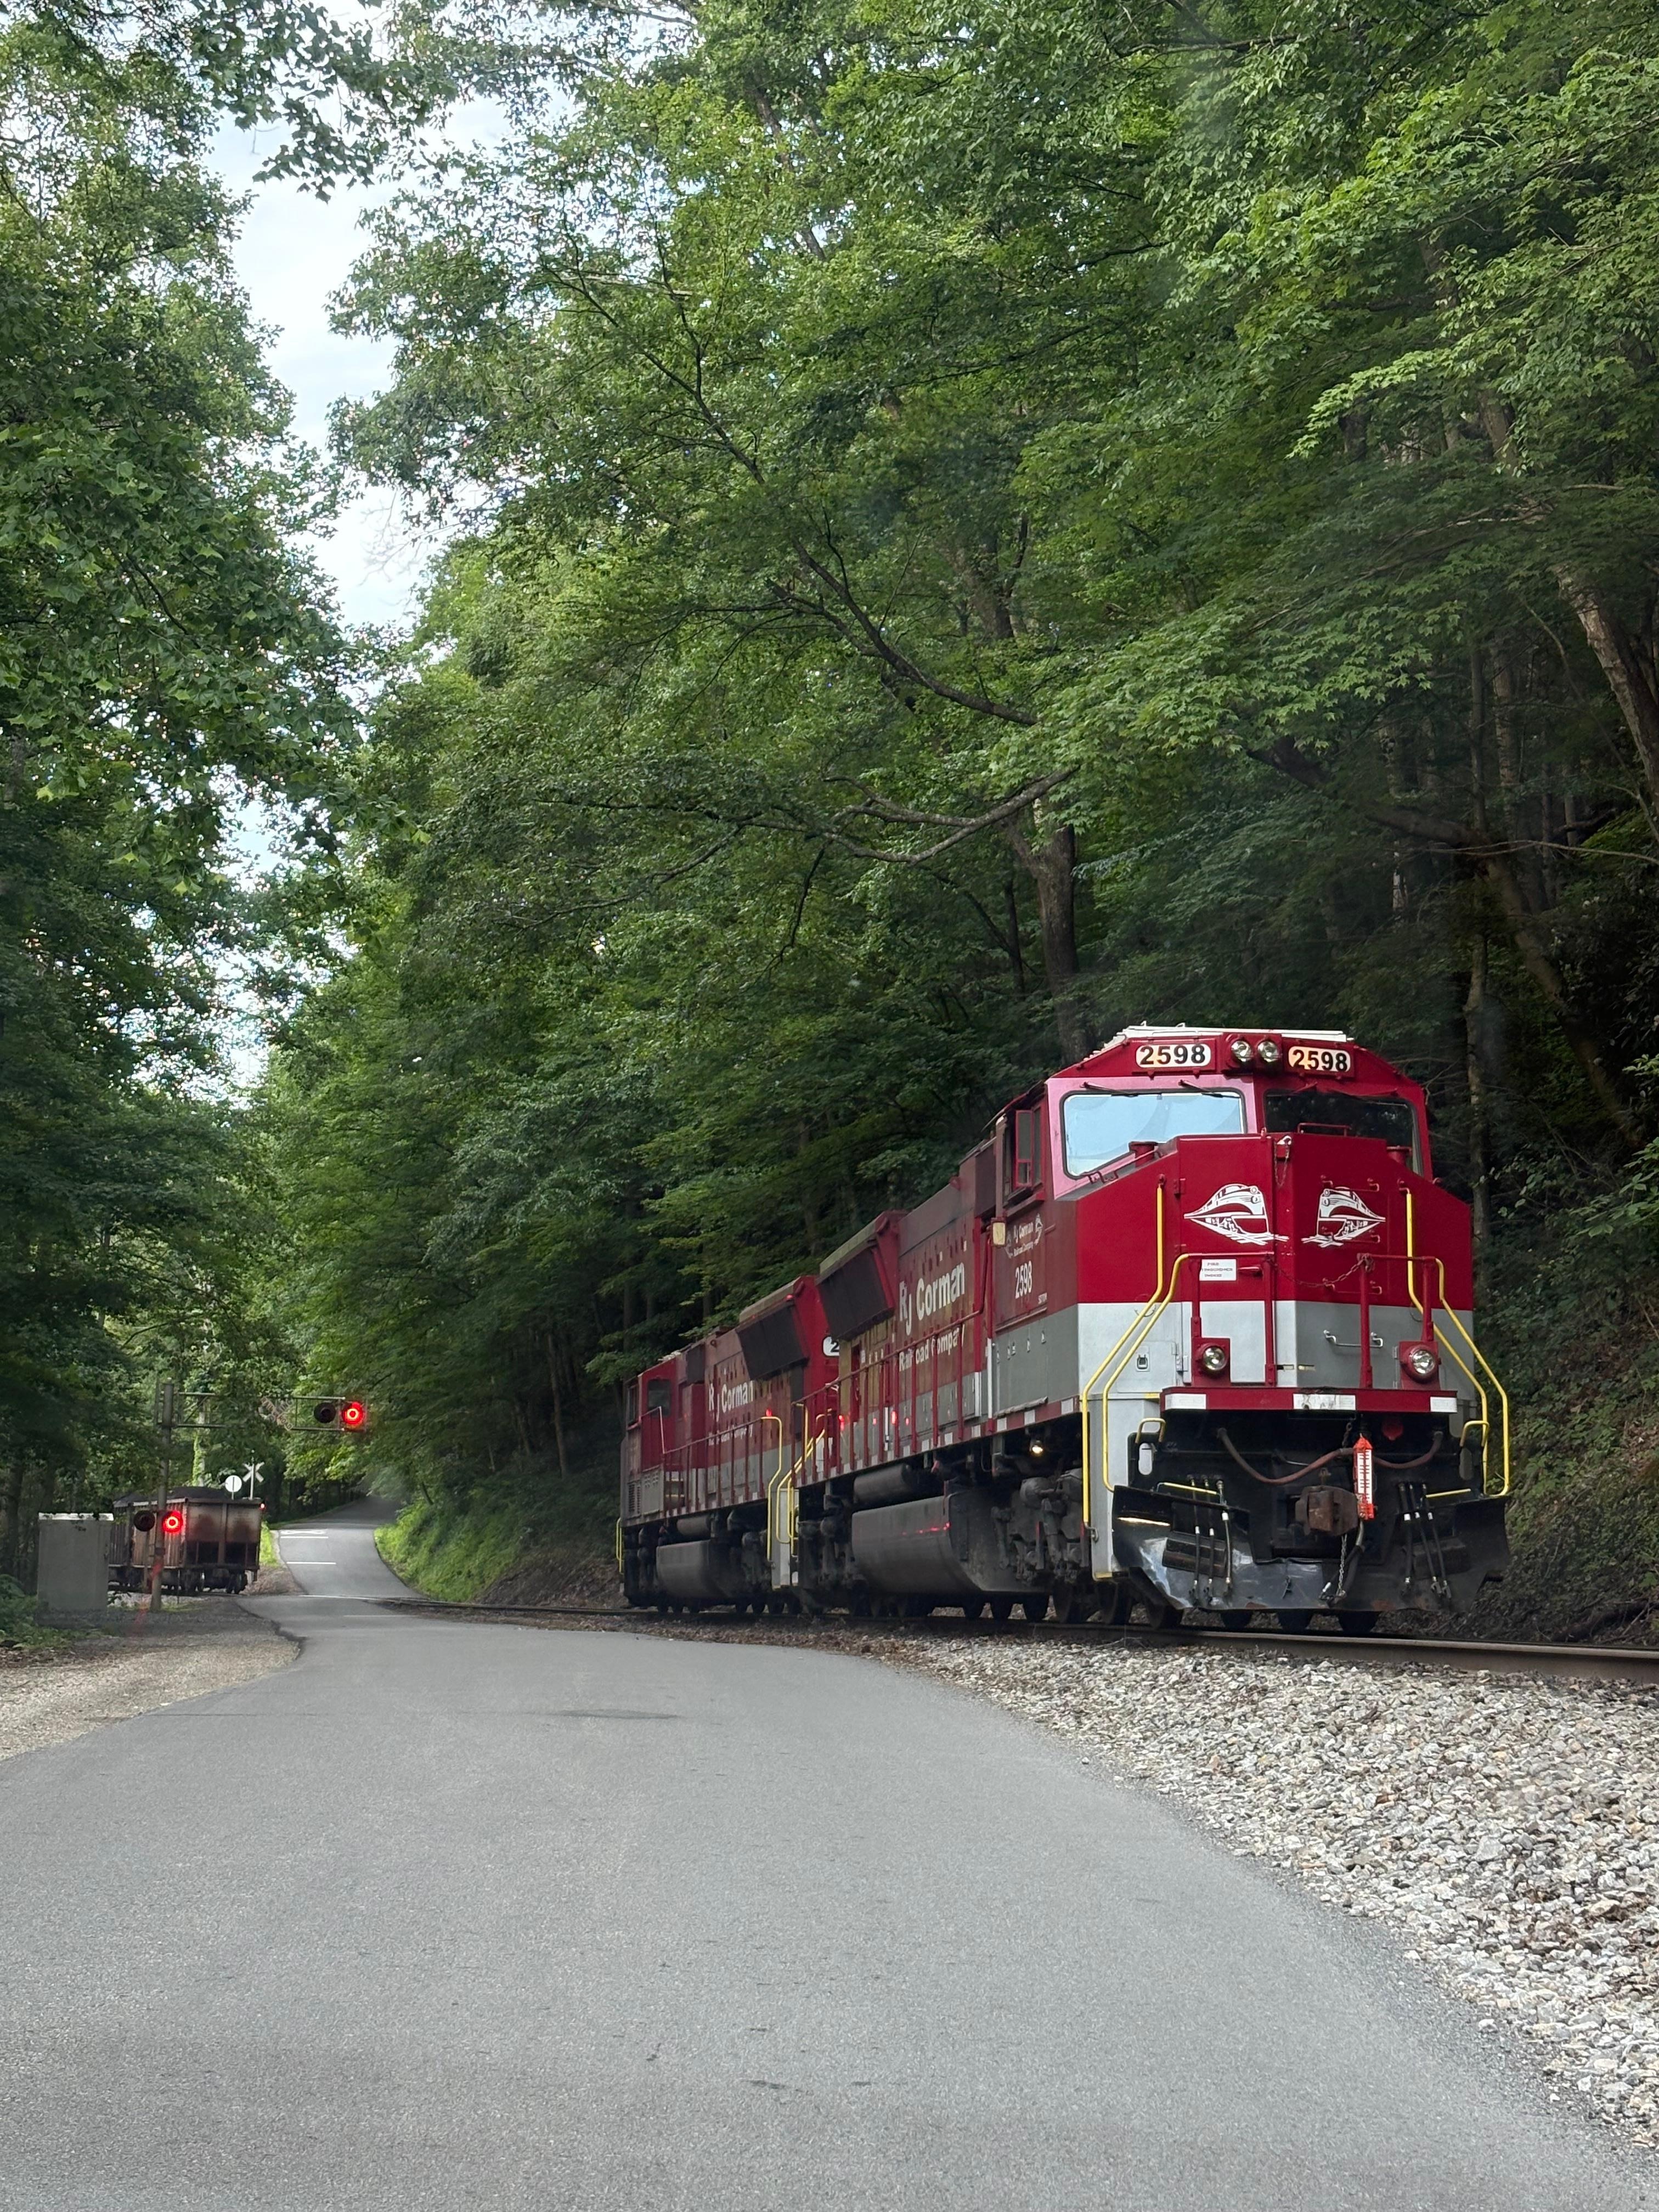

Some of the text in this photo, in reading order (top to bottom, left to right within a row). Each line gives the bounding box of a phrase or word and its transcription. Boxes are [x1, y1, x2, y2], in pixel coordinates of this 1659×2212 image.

[1139, 1045, 1206, 1065] 2598
[1292, 1049, 1348, 1072] 2598
[916, 1262, 965, 1321] Corman
[1015, 1260, 1032, 1299] 2598
[899, 1339, 929, 1372] Raiload
[721, 1380, 754, 1414] Corman
